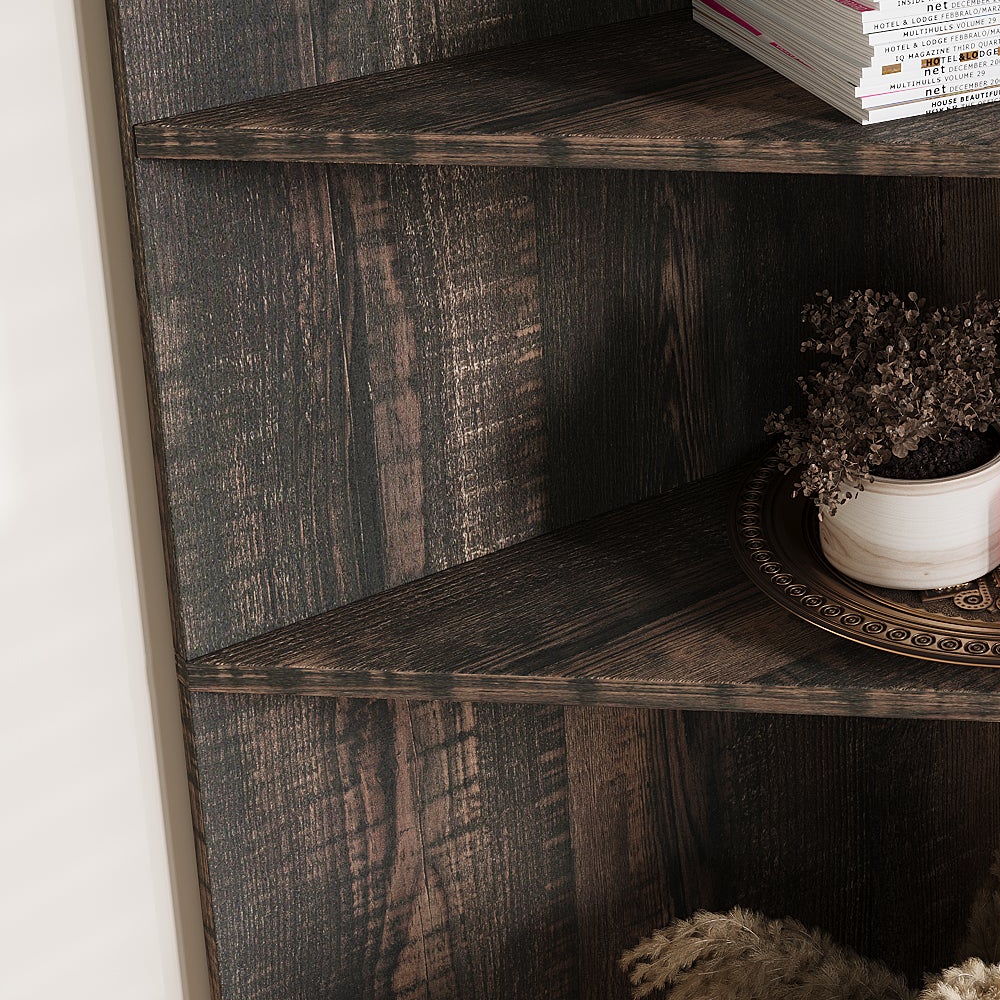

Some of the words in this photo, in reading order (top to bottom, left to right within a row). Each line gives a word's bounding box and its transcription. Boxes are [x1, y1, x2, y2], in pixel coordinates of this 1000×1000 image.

[927, 1, 949, 12] net
[874, 20, 899, 30] HOTEL
[912, 15, 938, 24] LODGE
[903, 24, 953, 37] MULTIHULLS
[957, 18, 985, 29] VOLUME
[988, 17, 997, 25] 29
[884, 43, 910, 54] HOTEL
[921, 38, 948, 47] LODGE
[908, 47, 950, 60] MAGAZINE
[953, 41, 976, 52] THIRD
[924, 66, 946, 77] net
[949, 60, 987, 73] DECEMBER
[890, 77, 941, 90] MULTIHULLS
[944, 72, 973, 82] VOLUME
[977, 70, 986, 78] 29
[926, 84, 946, 96] net
[950, 80, 987, 92] DECEMBER
[931, 98, 957, 108] HOUSE
